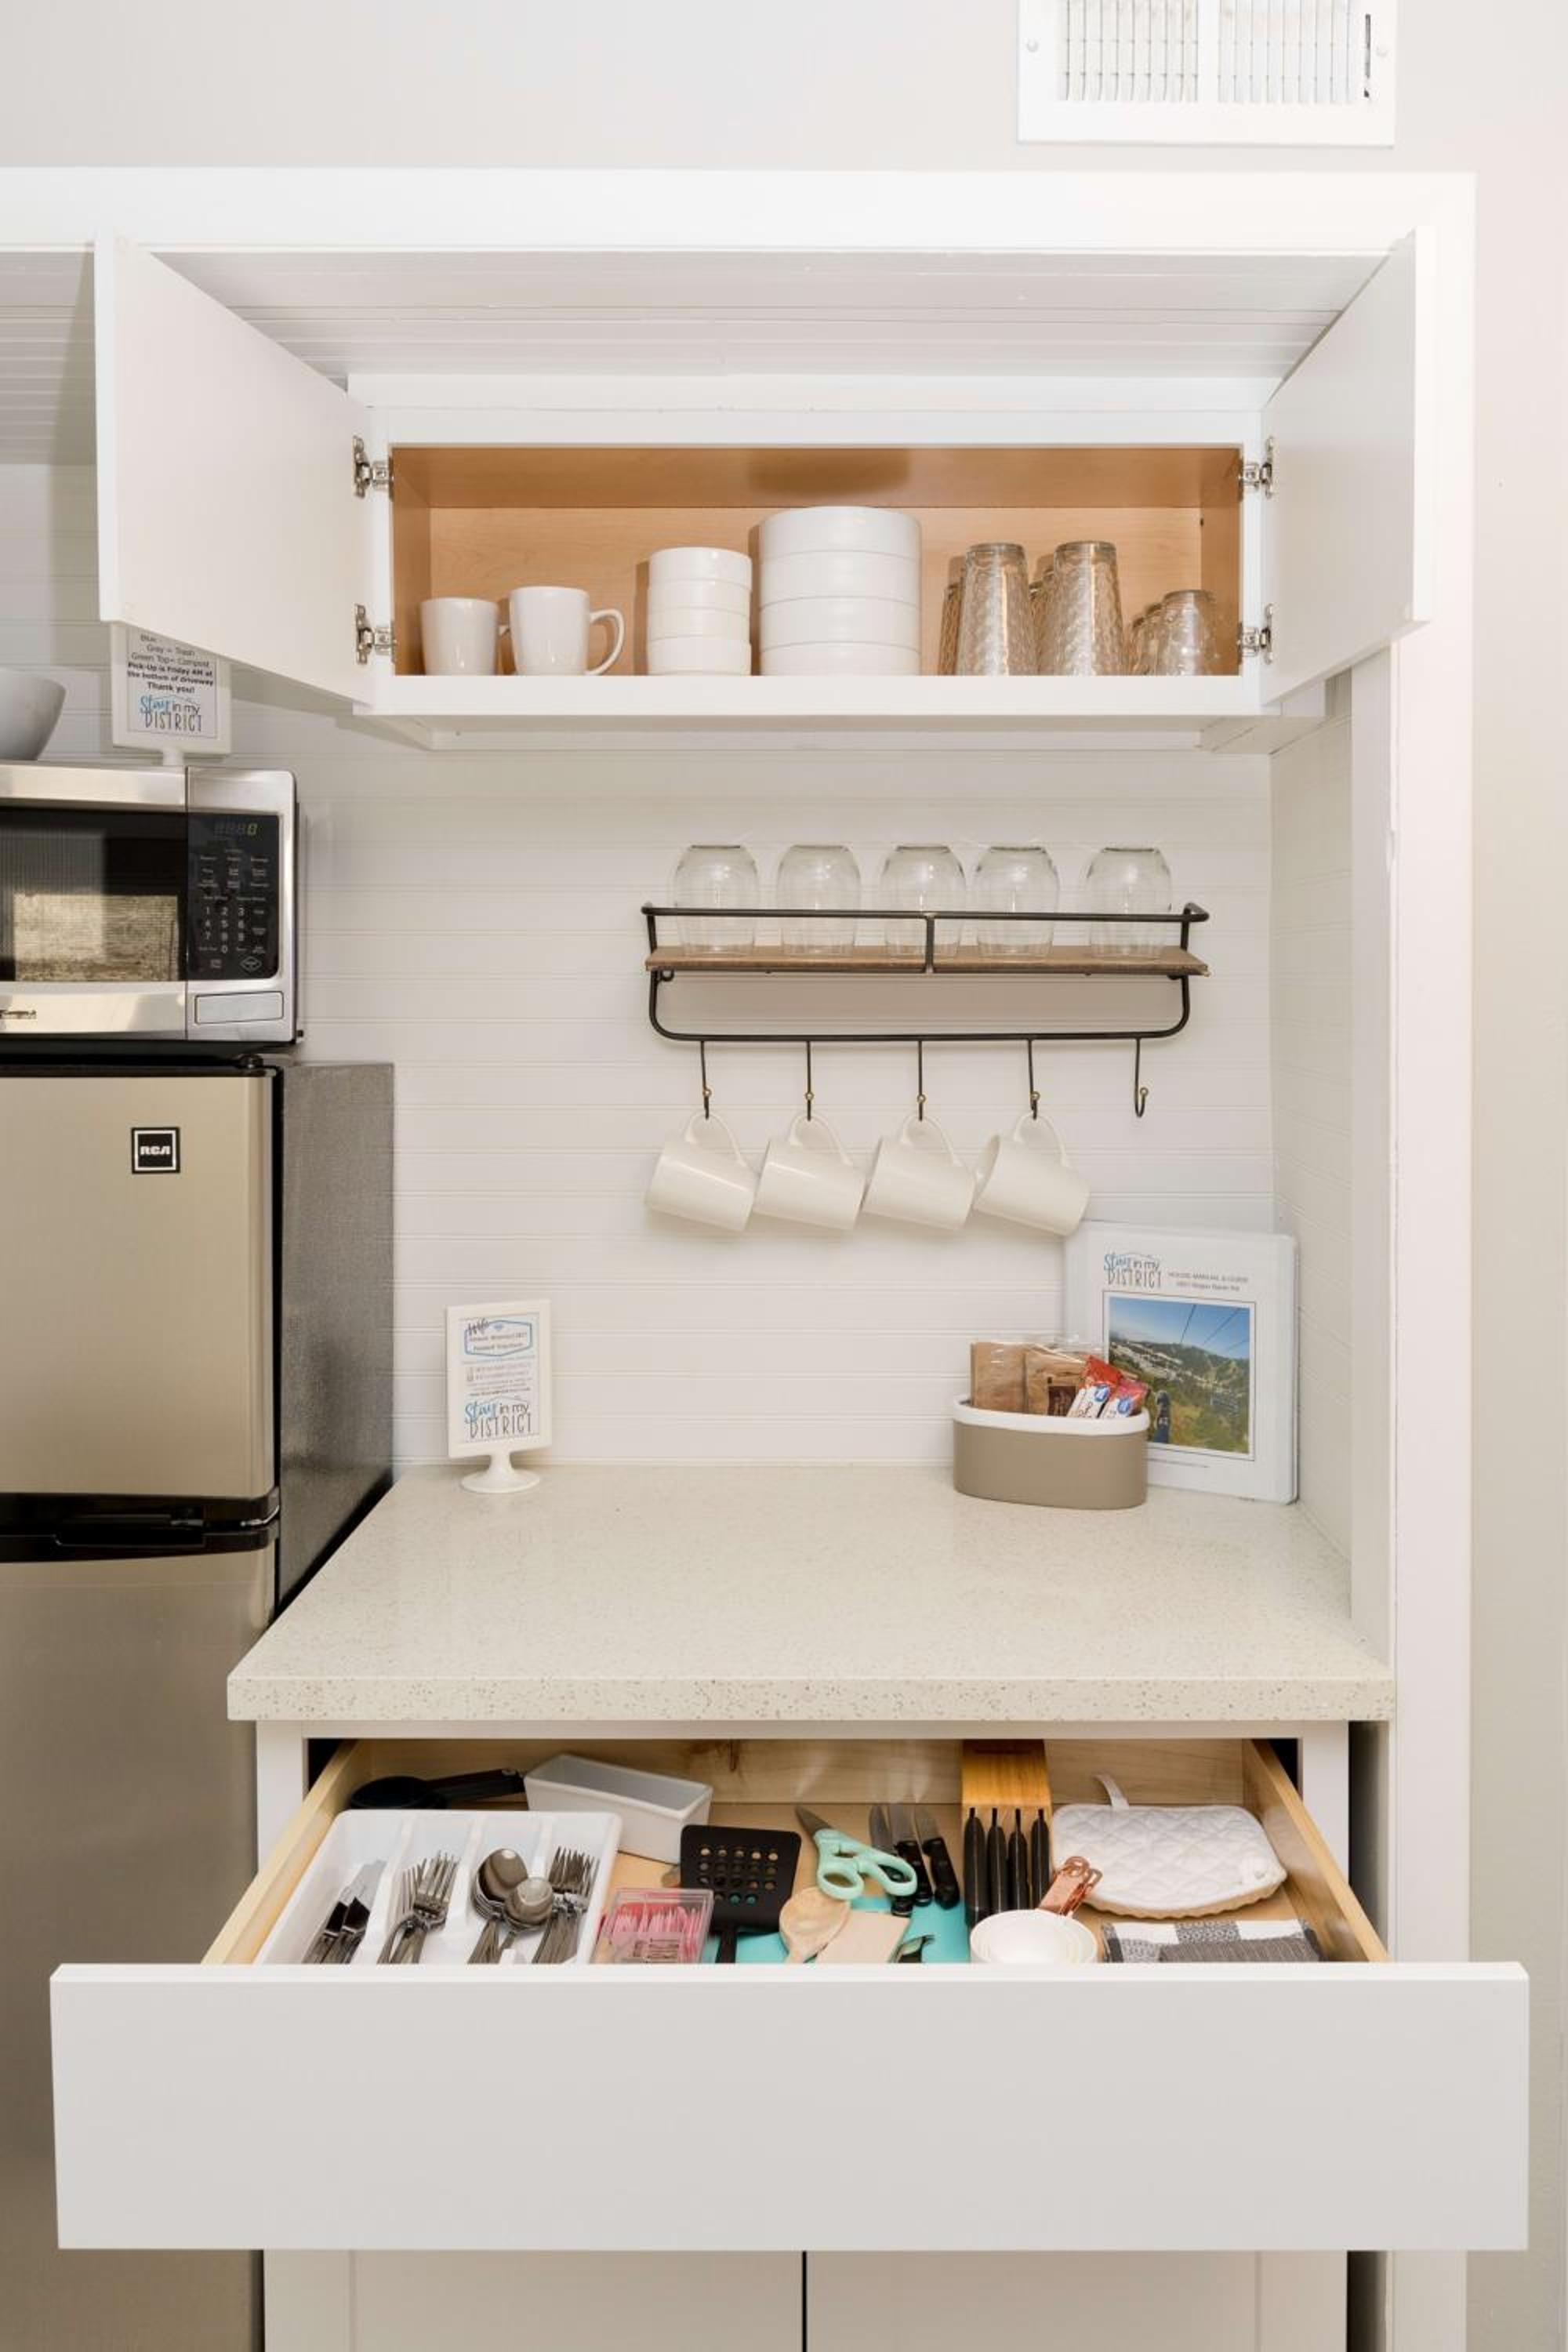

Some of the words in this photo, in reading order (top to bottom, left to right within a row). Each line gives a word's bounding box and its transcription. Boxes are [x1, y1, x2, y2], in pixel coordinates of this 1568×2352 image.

[131, 652, 154, 661] Green
[168, 666, 190, 676] Friday
[142, 672, 169, 681] bottom
[180, 677, 213, 687] driveway
[147, 681, 173, 690] Thank
[184, 704, 200, 715] my
[145, 710, 201, 732] DISTRICT
[221, 906, 228, 916] 2
[140, 1145, 171, 1156] RCA
[1108, 1268, 1162, 1289] DISTRICT
[464, 1401, 497, 1425] Stay
[499, 1403, 510, 1414] in
[512, 1403, 530, 1416] my
[470, 1412, 532, 1439] DISTRICT
